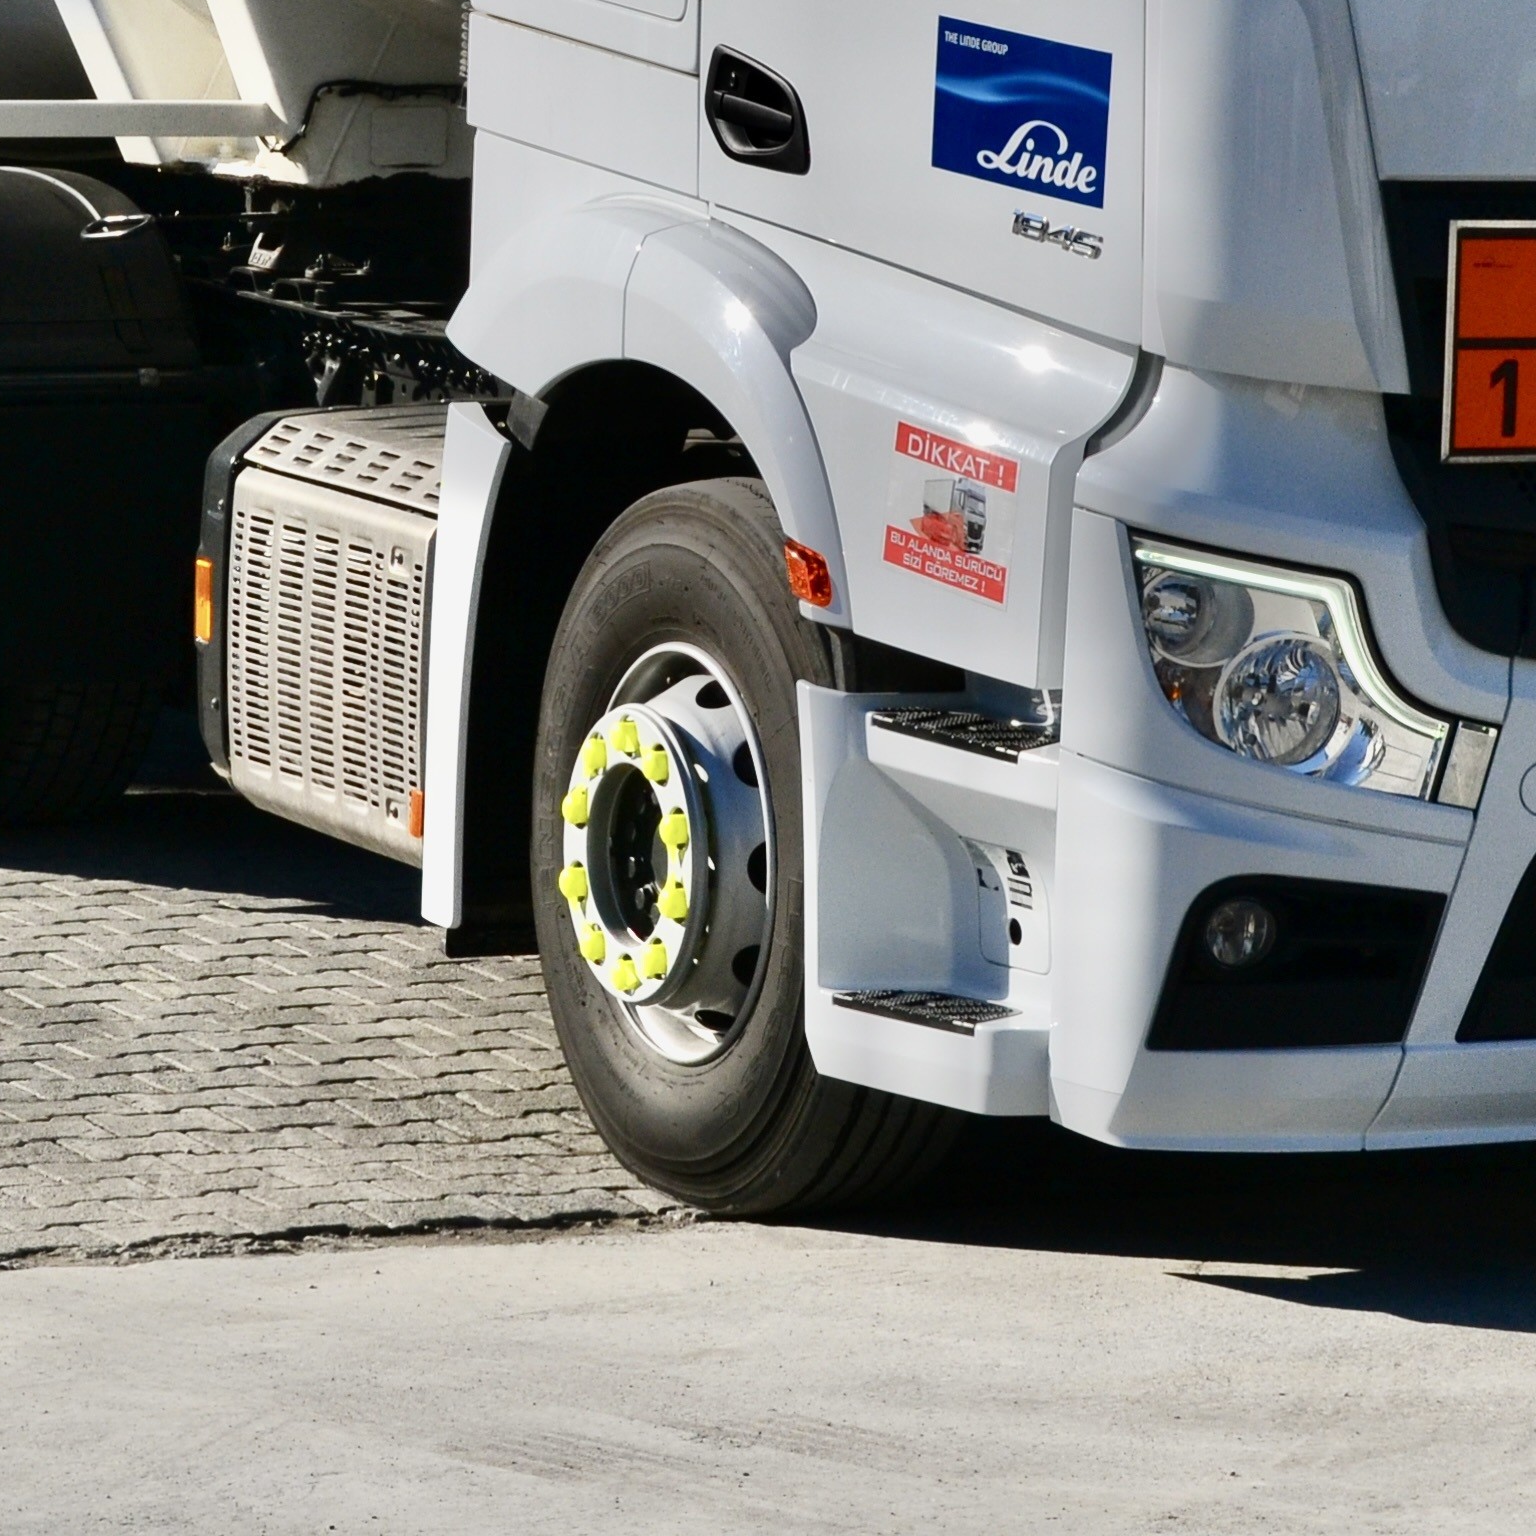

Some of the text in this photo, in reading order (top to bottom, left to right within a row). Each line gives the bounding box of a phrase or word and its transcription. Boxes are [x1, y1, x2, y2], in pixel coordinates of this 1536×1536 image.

[944, 31, 958, 44] THE
[981, 39, 1009, 56] GROUP
[976, 119, 1098, 194] Linde
[1012, 208, 1104, 260] 1845
[907, 433, 990, 480] DİKKAT
[890, 532, 906, 546] BU
[907, 536, 952, 564] ALANDA
